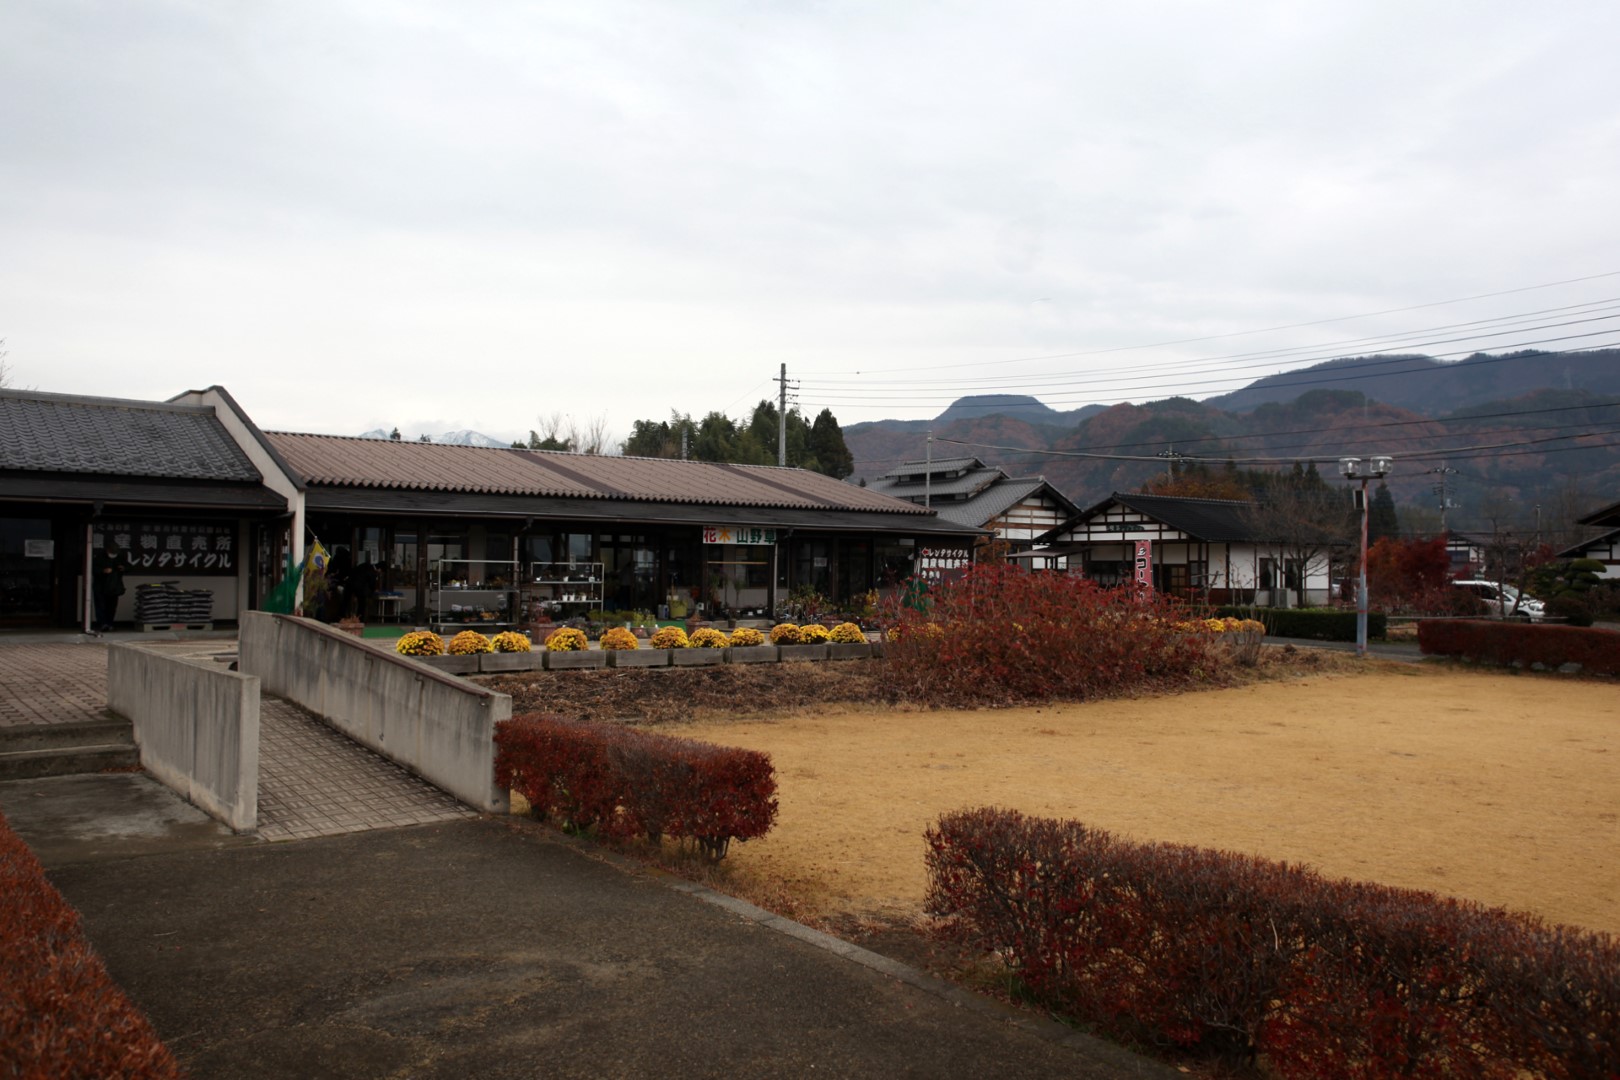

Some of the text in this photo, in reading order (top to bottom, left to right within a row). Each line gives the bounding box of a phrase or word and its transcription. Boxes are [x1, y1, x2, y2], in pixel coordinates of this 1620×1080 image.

[704, 526, 776, 544] 花木 山野草
[127, 551, 232, 568] レンタサイクル
[928, 548, 969, 558] レンタサイクル
